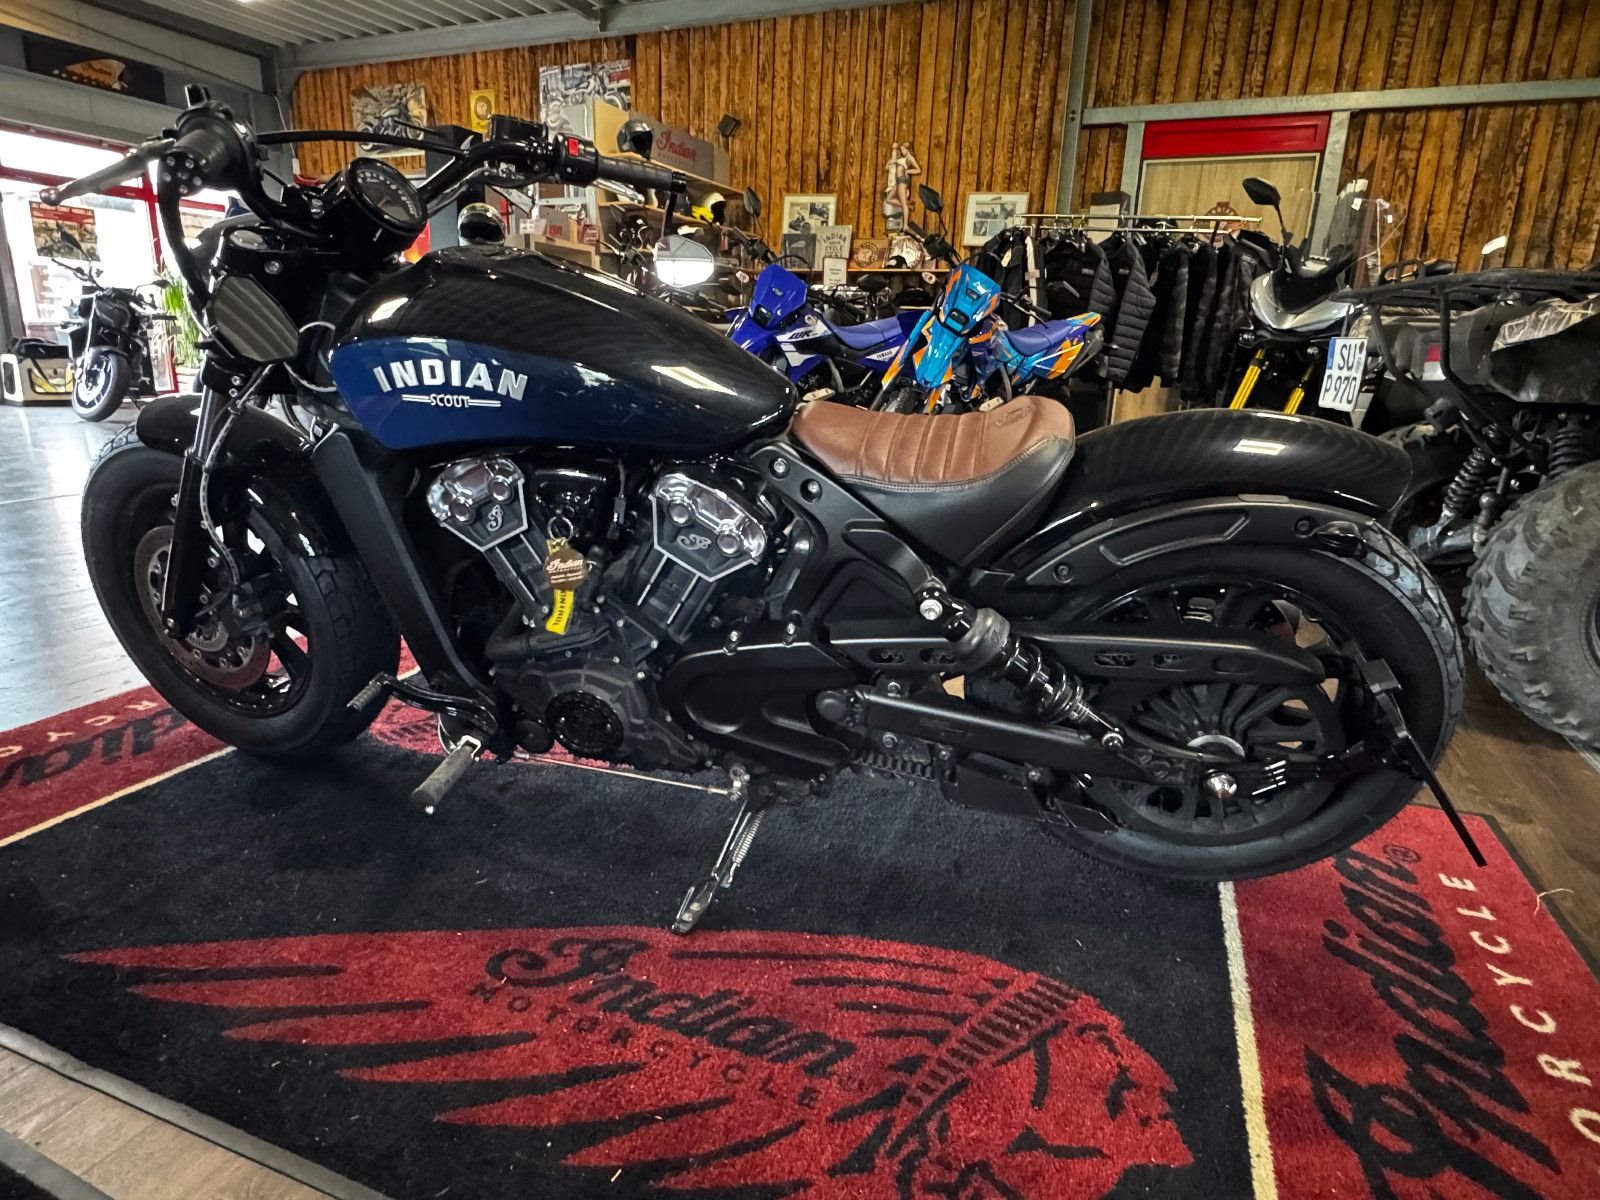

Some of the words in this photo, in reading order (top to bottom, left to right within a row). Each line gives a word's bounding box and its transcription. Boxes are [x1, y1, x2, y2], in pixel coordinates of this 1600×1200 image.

[656, 130, 697, 161] Indian
[1338, 343, 1358, 371] SU
[373, 358, 528, 401] INDIAN
[430, 393, 470, 408] SCOUT
[485, 937, 857, 1079] Indian
[470, 981, 822, 1109] MOTORCYCLE
